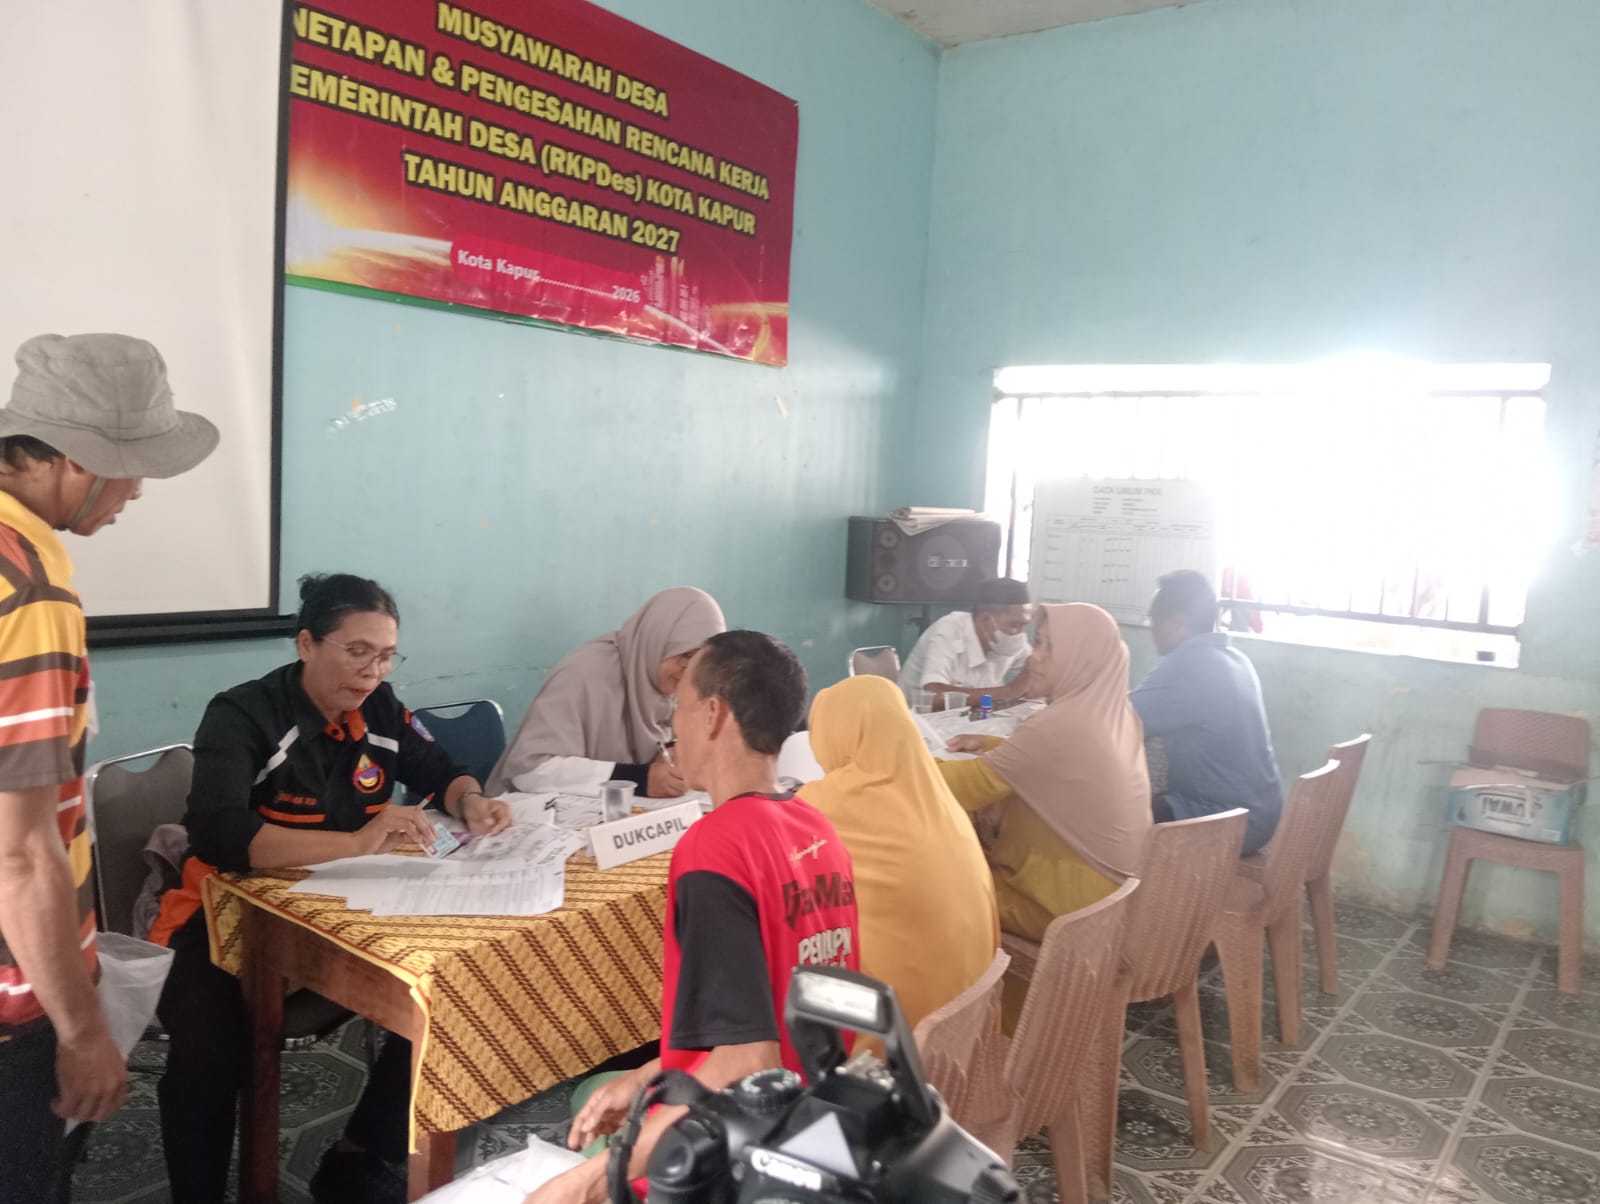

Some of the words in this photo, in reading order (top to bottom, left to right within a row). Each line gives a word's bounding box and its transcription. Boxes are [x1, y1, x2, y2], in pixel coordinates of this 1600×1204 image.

[437, 2, 612, 93] MUSYAWARAH
[615, 74, 669, 117] DESA
[290, 63, 463, 142] EMERINTAH
[469, 120, 537, 165] DESA
[541, 144, 643, 202] (RKPDes)
[646, 178, 695, 215] KOTA
[698, 196, 755, 235] KAPUR
[432, 55, 455, 87] &
[460, 65, 621, 144] PENGESAHAN
[625, 125, 716, 180] RENCANA
[719, 161, 770, 200] KERJA
[404, 153, 495, 202] TAHUN
[500, 182, 629, 239] ANGGARAN
[631, 220, 680, 252] 2027
[457, 249, 493, 270] Kota
[612, 817, 689, 850] DUKCAPIL
